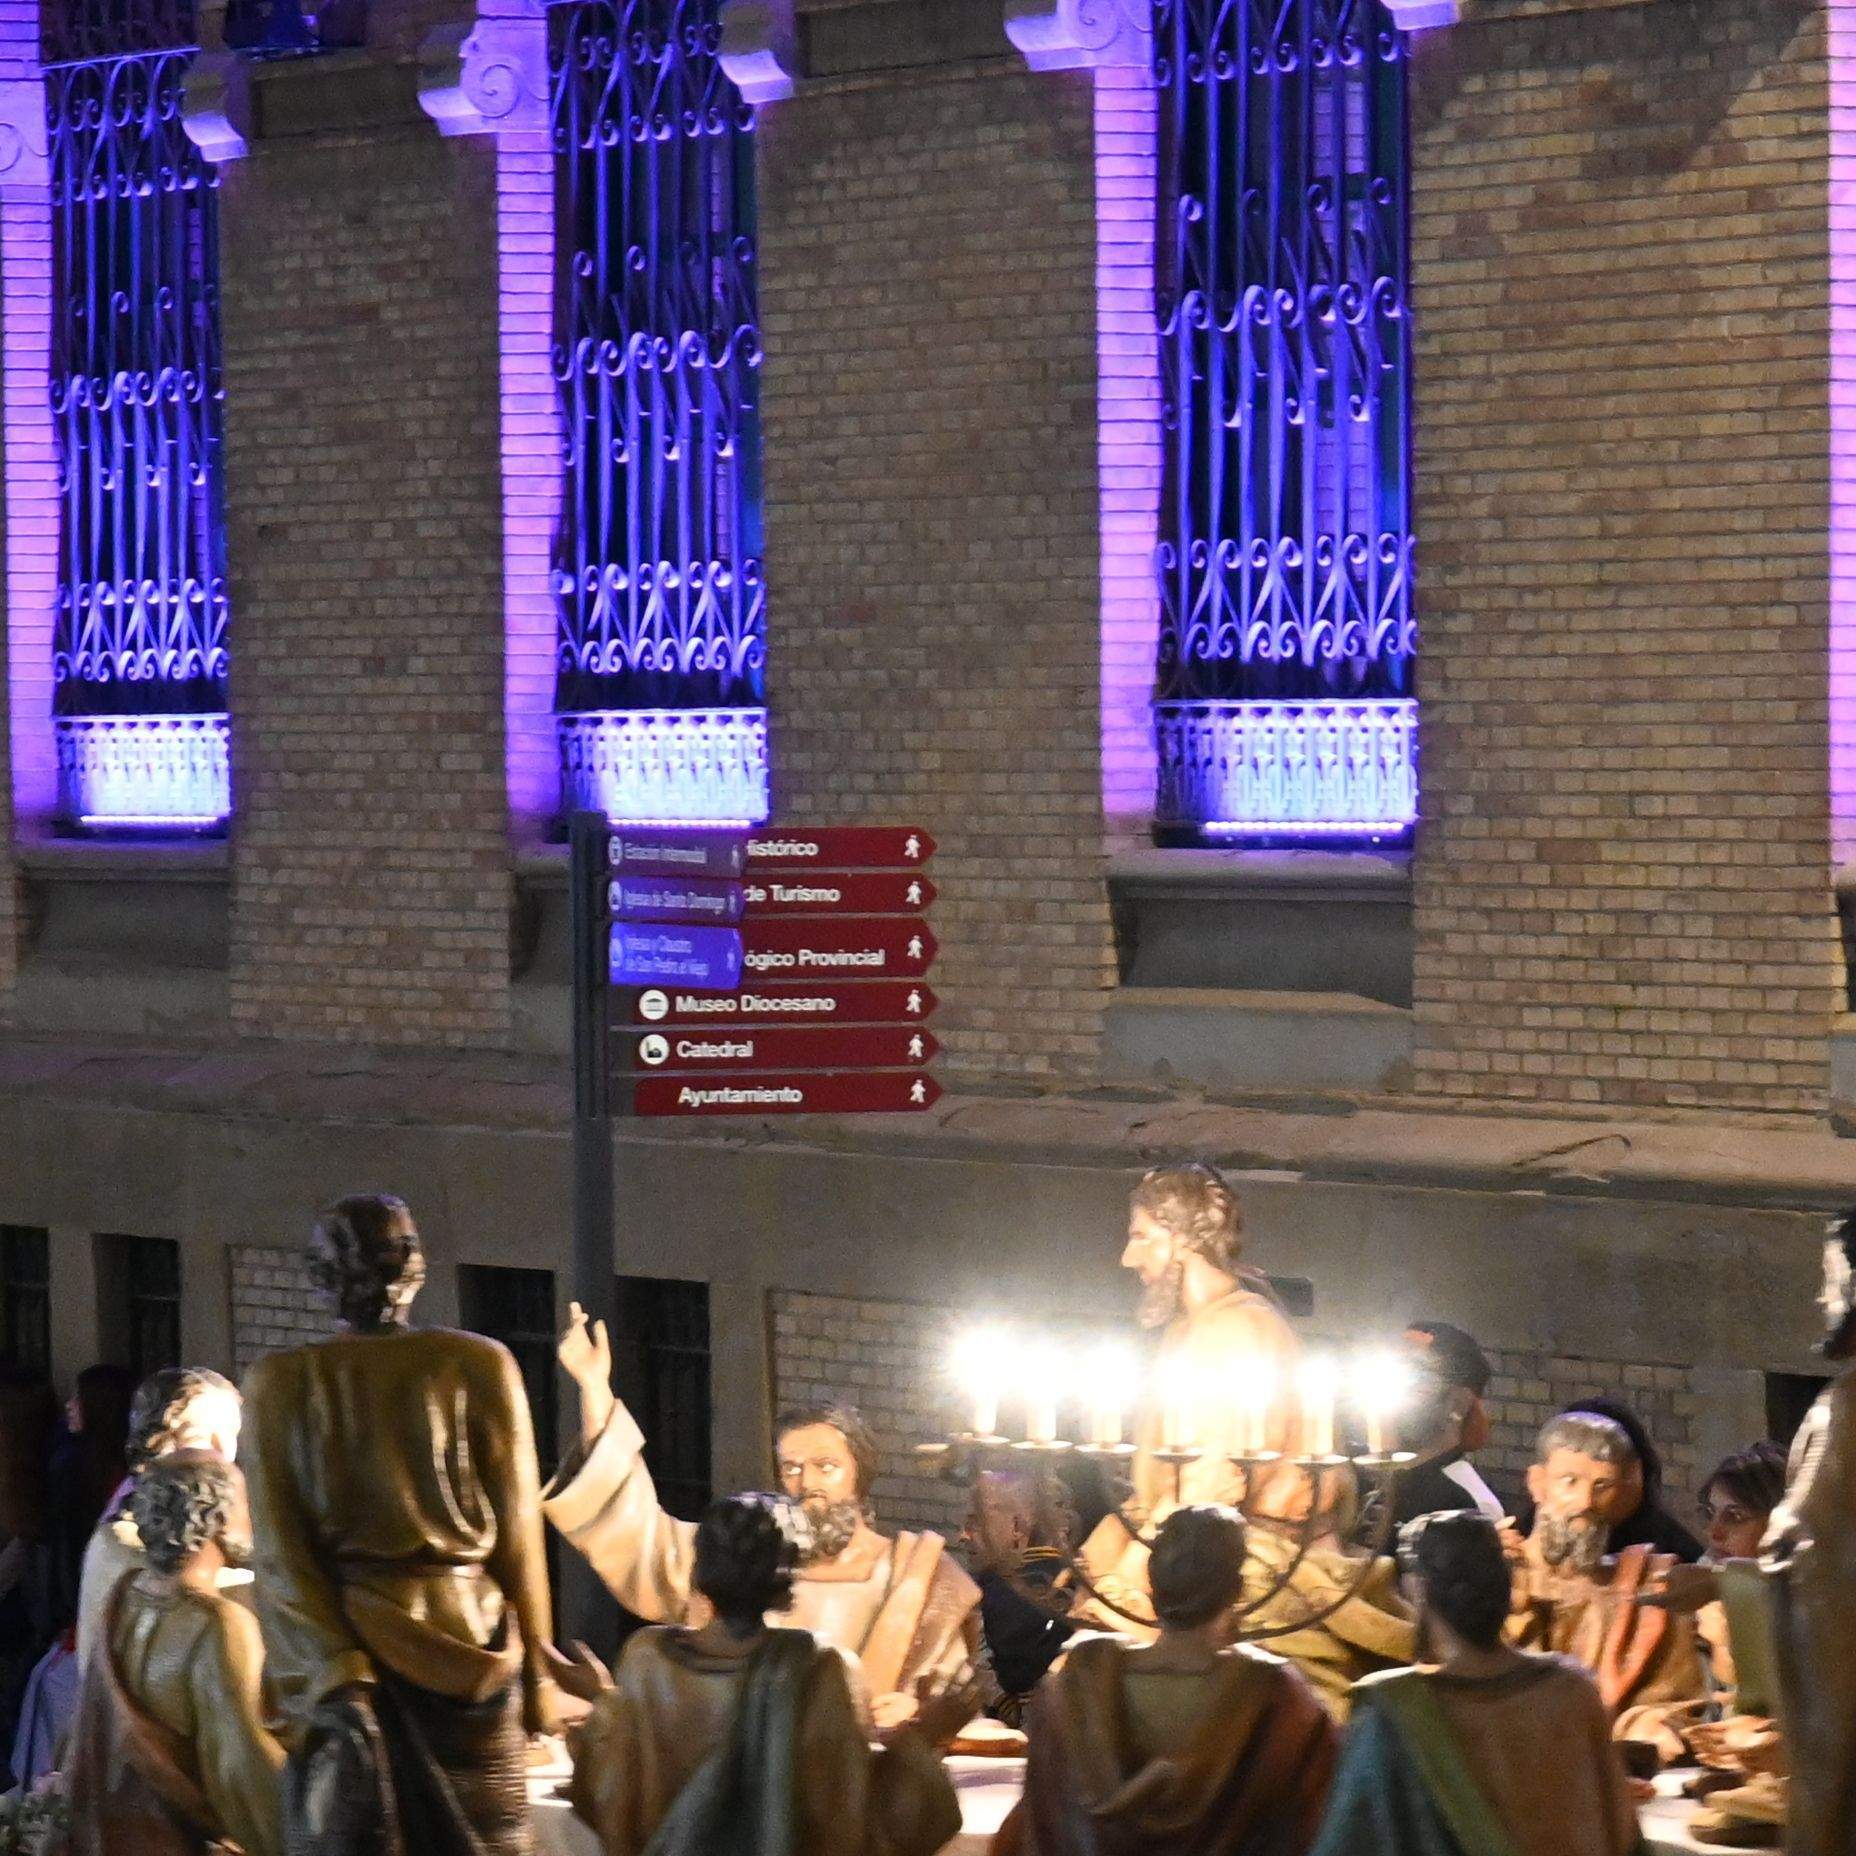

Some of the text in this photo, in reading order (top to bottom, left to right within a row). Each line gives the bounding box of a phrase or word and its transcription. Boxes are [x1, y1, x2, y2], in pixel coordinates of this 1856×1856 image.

[743, 884, 841, 902] de Turismo
[798, 949, 885, 966] Provincial
[675, 995, 836, 1012] Museo Diocesano
[676, 1040, 753, 1058] Catedral
[678, 1086, 803, 1107] Ayuntamiento
